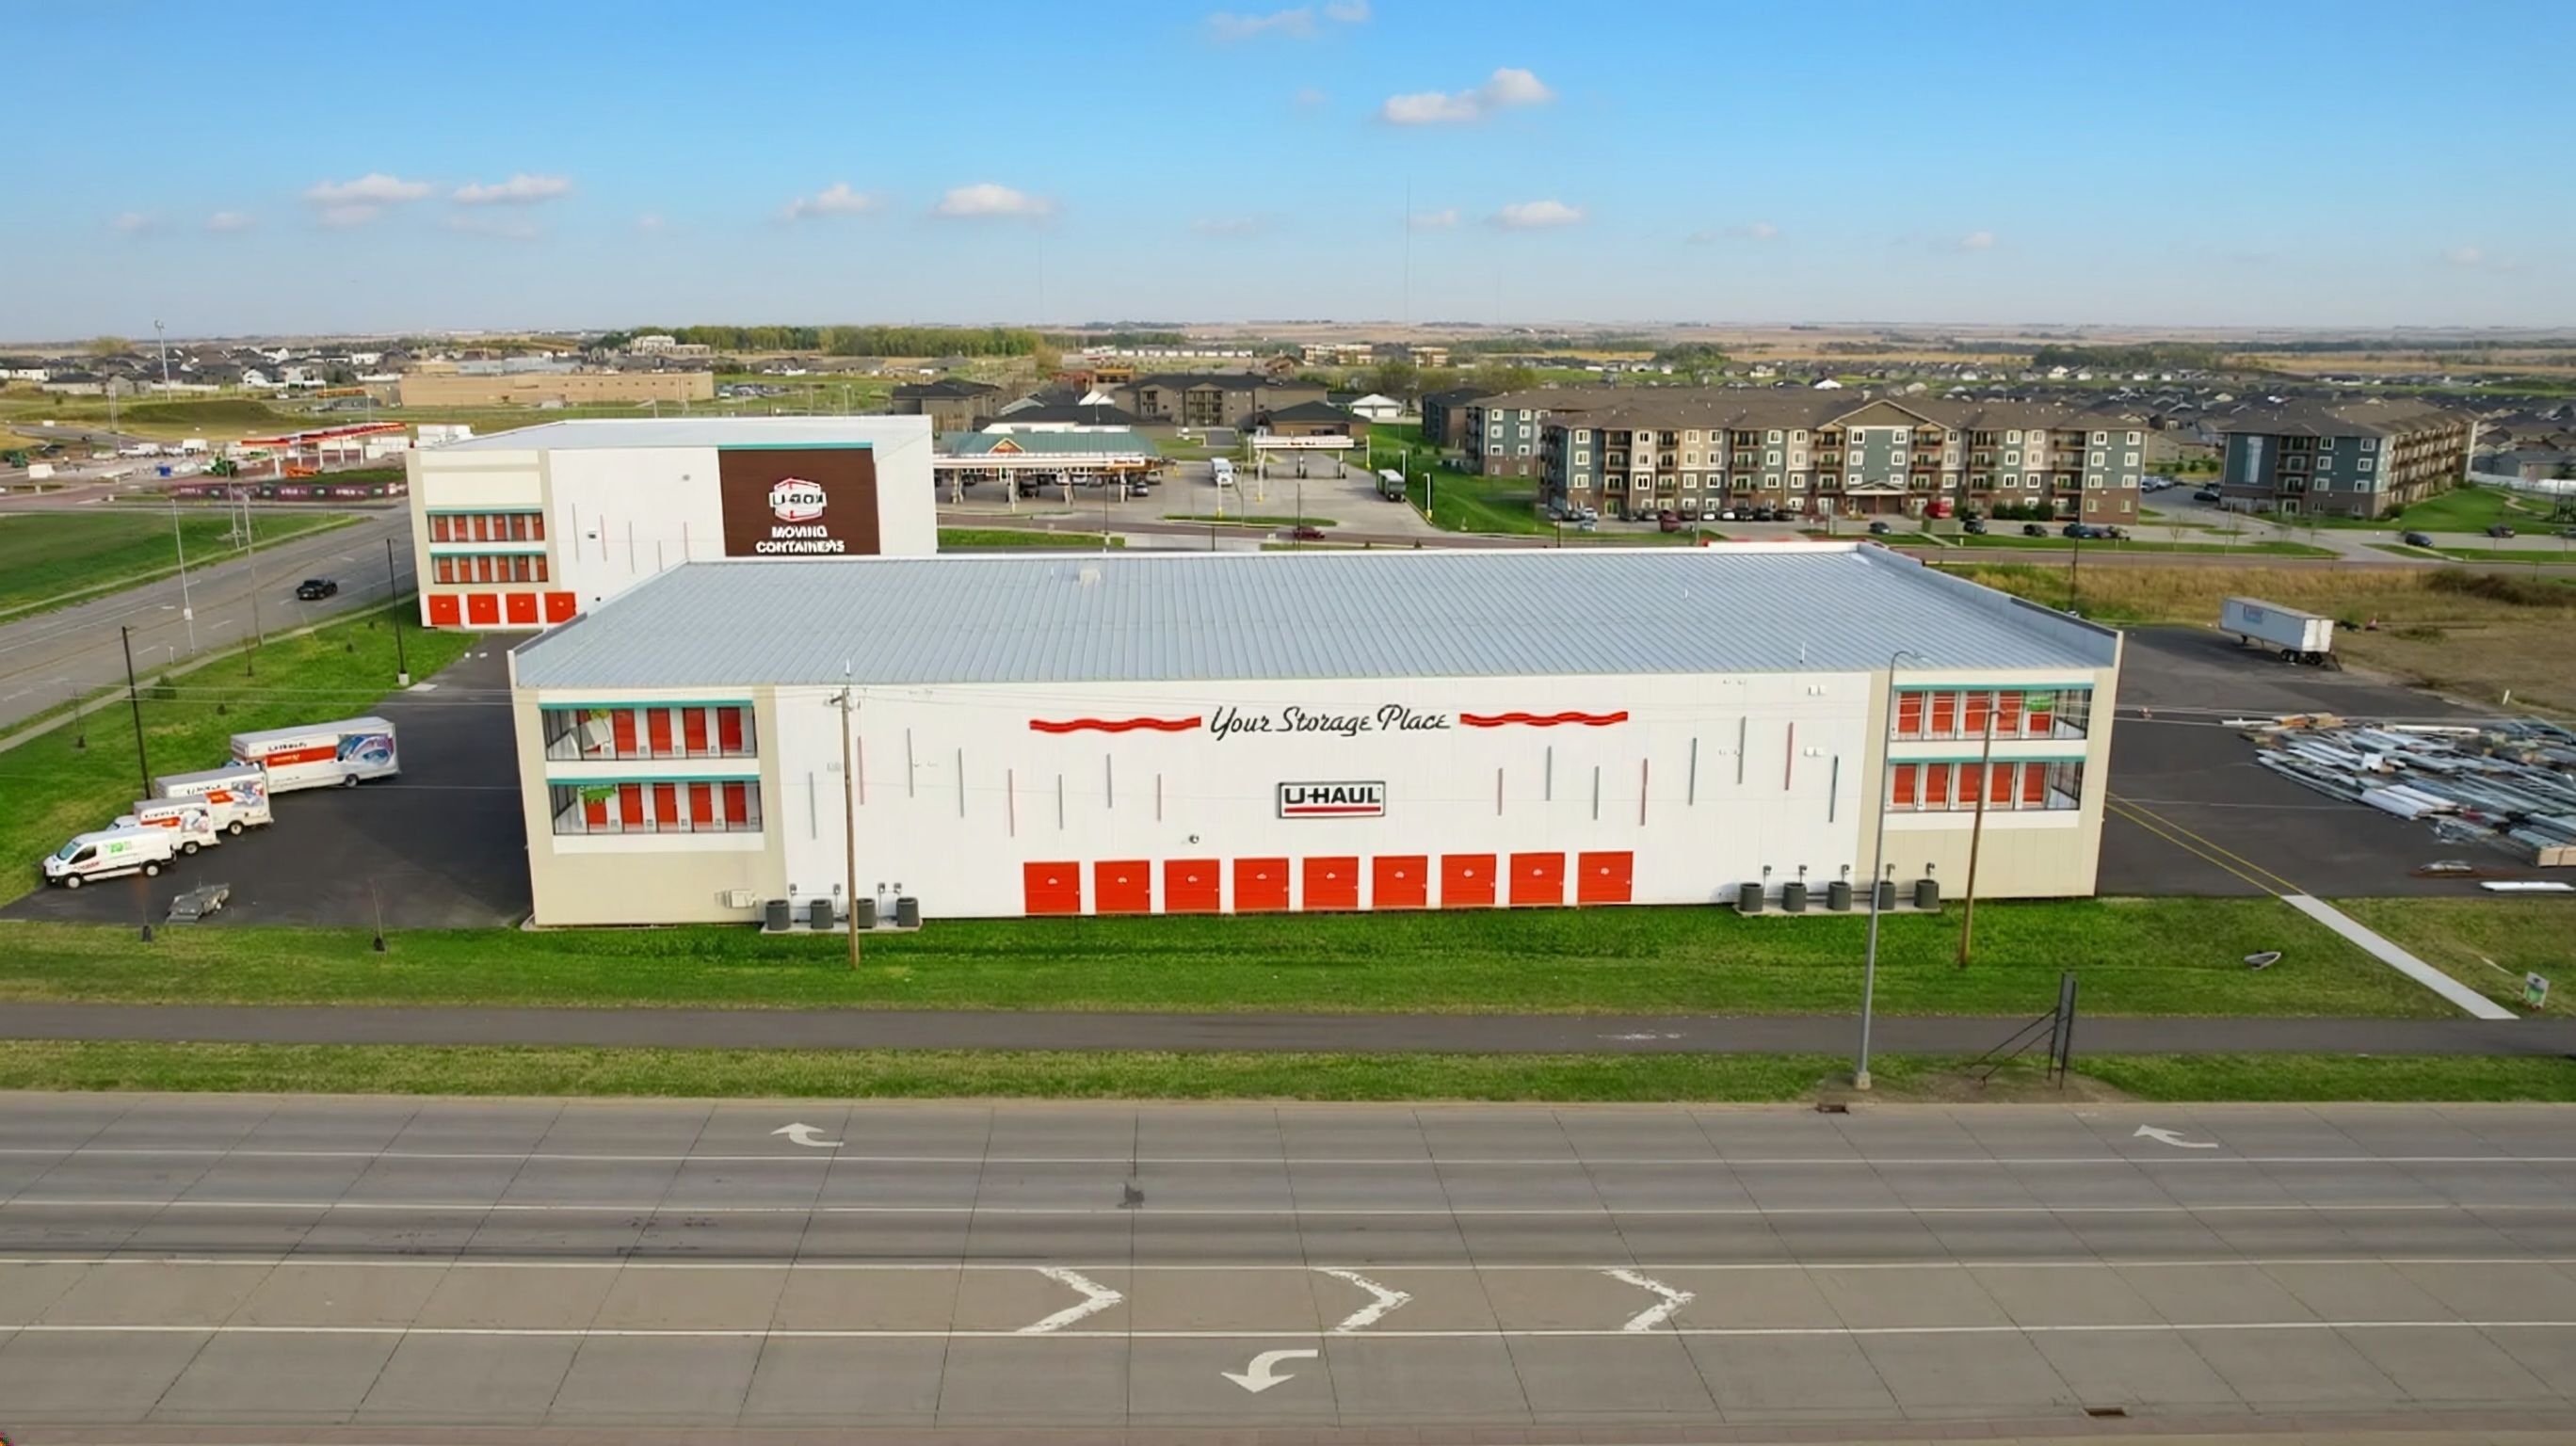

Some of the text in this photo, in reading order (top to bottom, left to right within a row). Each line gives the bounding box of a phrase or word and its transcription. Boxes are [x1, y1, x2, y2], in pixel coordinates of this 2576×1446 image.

[1210, 703, 1451, 741] Your Storage Place
[1283, 786, 1381, 805] U-HAUL
